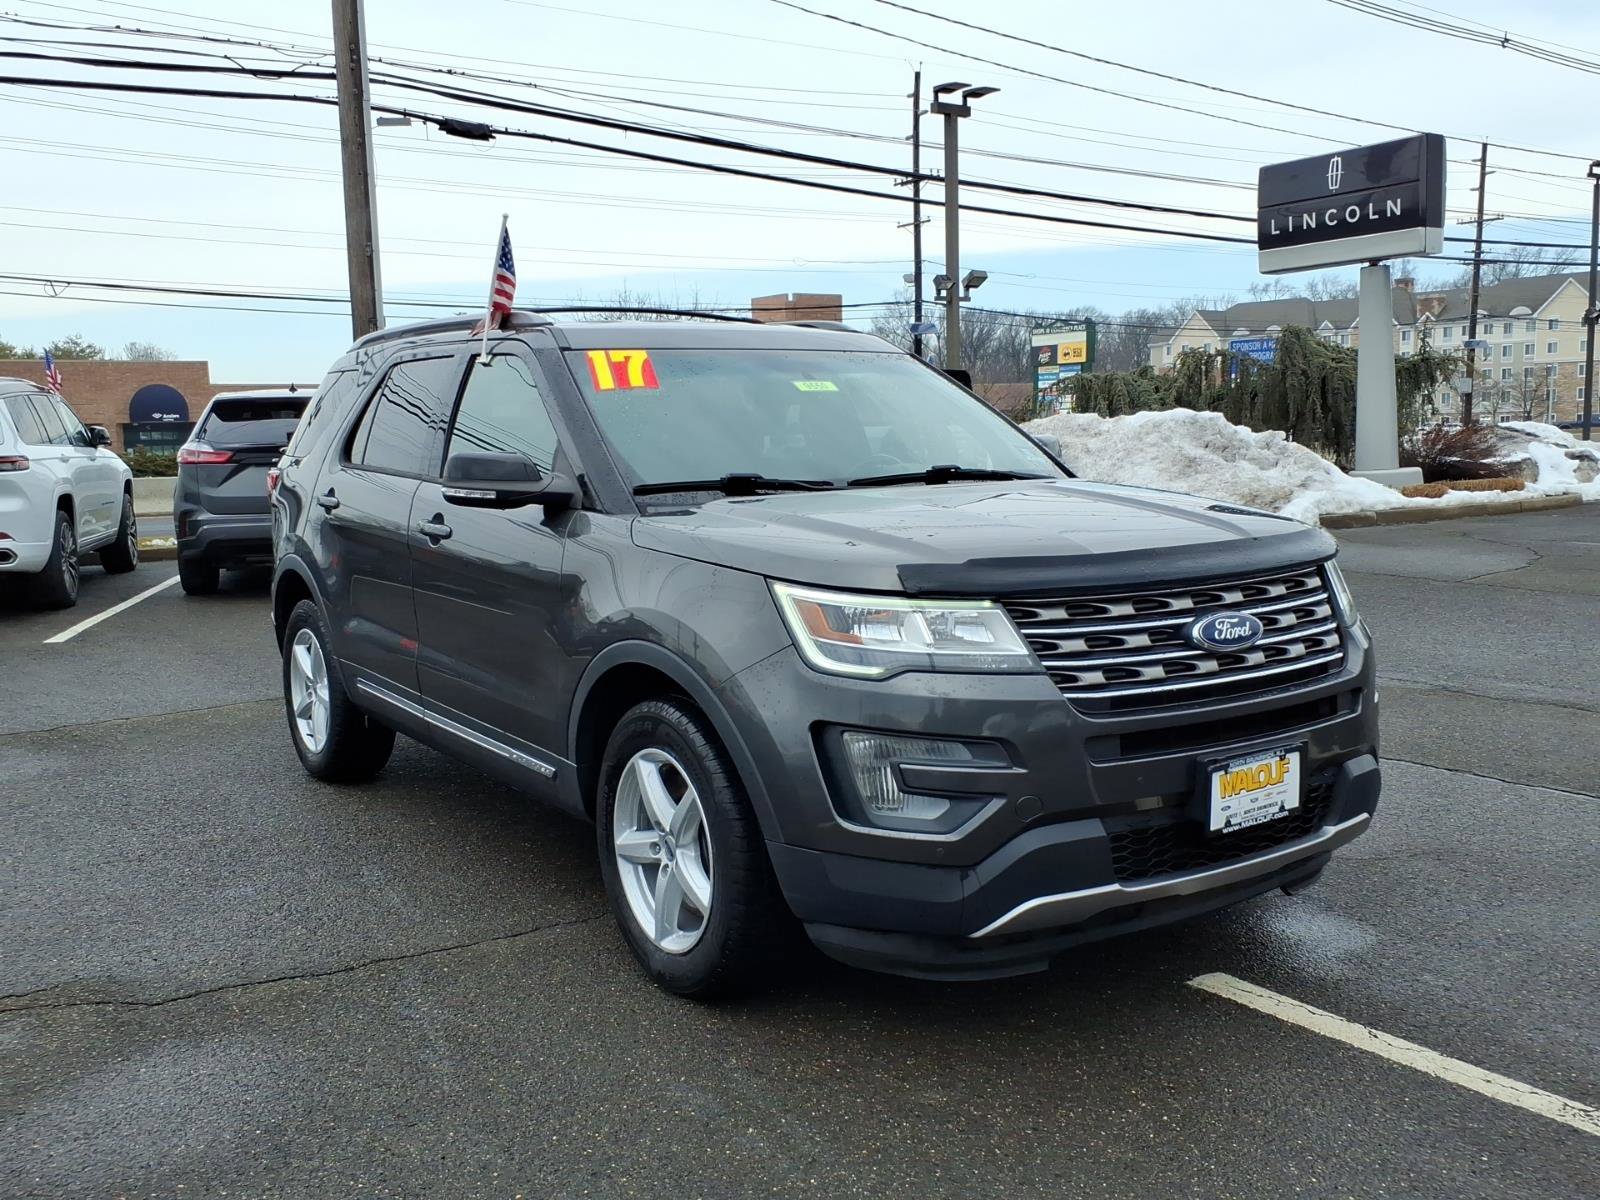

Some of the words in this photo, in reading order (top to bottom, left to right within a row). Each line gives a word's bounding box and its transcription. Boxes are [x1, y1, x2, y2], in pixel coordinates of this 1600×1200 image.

[1271, 198, 1401, 235] LINCOLN
[1232, 341, 1261, 352] SPONSOR
[586, 350, 648, 390] 17
[1215, 617, 1252, 640] Ford
[1219, 757, 1291, 799] MALOUF
